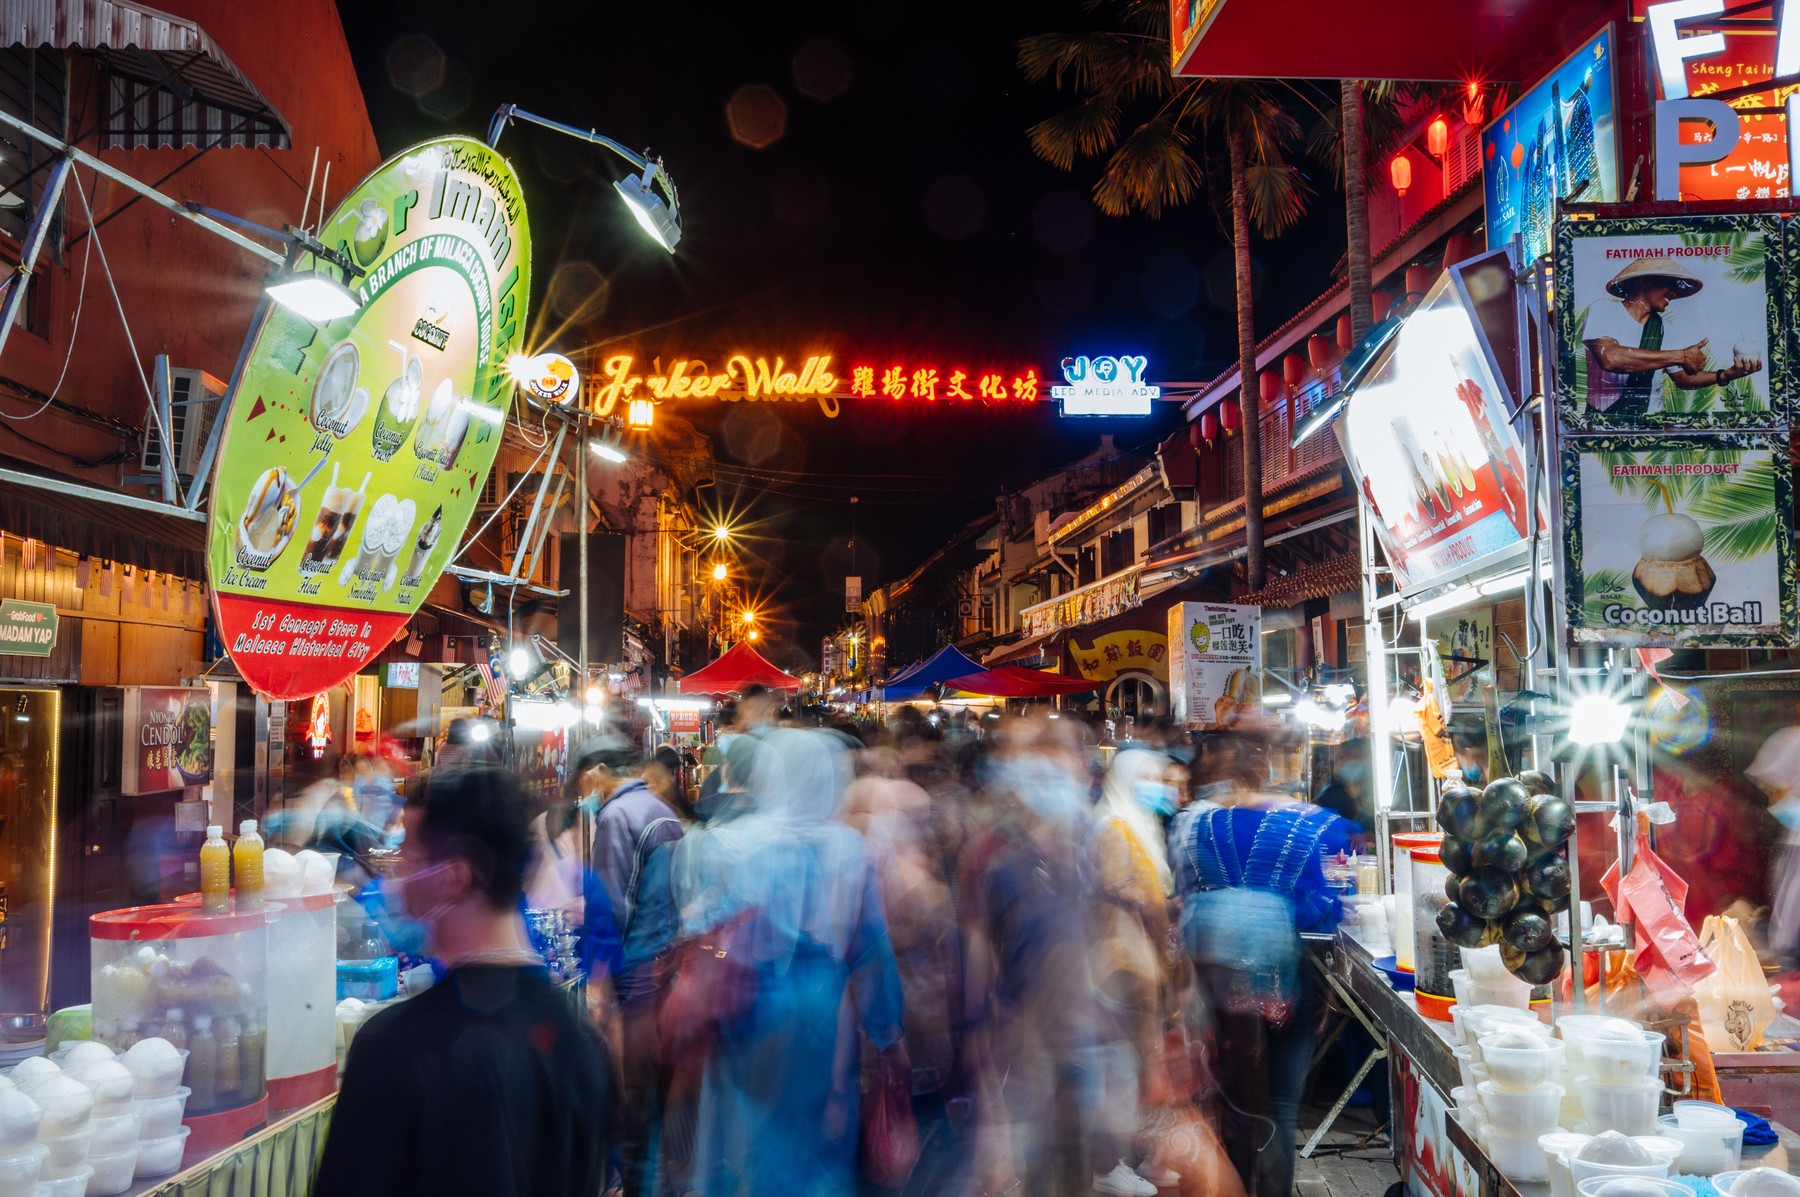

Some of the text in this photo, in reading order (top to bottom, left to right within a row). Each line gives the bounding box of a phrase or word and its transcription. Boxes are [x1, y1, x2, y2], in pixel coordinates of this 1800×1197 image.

[1692, 63, 1732, 77] Sheng
[1736, 63, 1758, 74] Tai
[1502, 206, 1516, 222] SAIL
[1606, 246, 1731, 259] FATIMAH PRODUCT
[359, 236, 492, 369] A BRANCH OF MALACCA COCONUT HOUSE
[428, 171, 519, 444] Imam Isha
[727, 355, 838, 398] Walk
[1063, 355, 1148, 384] JOY
[1054, 386, 1077, 397] LED
[1084, 386, 1124, 397] MEDIA
[316, 408, 349, 435] Coconut
[375, 420, 404, 445] Coconut
[308, 431, 333, 459] Jelly
[371, 441, 396, 464] Fresh
[1613, 464, 1740, 476] FATIMAH PRODUCT
[236, 545, 273, 569] Coconut
[301, 553, 335, 576] Coconut
[220, 565, 268, 591] Ice Cream
[297, 575, 321, 596] Float
[358, 564, 386, 583] Coconut
[11, 610, 37, 623] GrabFood
[251, 609, 276, 631] 1st
[279, 613, 326, 639] Concept
[328, 619, 358, 637] Store
[1604, 601, 1763, 625] Coconut Ball
[0, 625, 53, 645] MADAM YAP
[1211, 623, 1245, 640] 一口吃
[232, 633, 371, 664] Malacca Historical City
[141, 723, 183, 747] CENDOL
